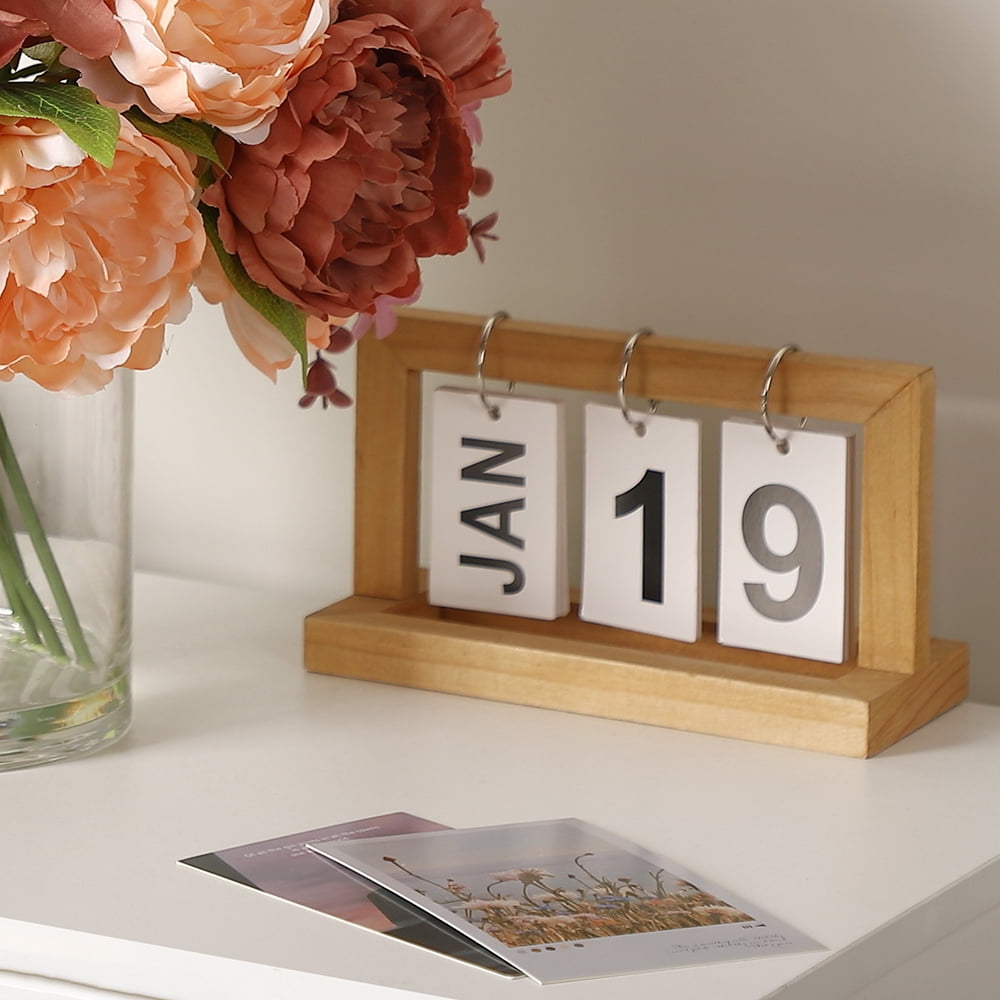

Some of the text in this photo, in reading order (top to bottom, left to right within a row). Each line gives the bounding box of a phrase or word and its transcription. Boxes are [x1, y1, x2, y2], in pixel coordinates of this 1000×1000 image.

[459, 436, 527, 596] JAN
[614, 468, 825, 624] 1 9
